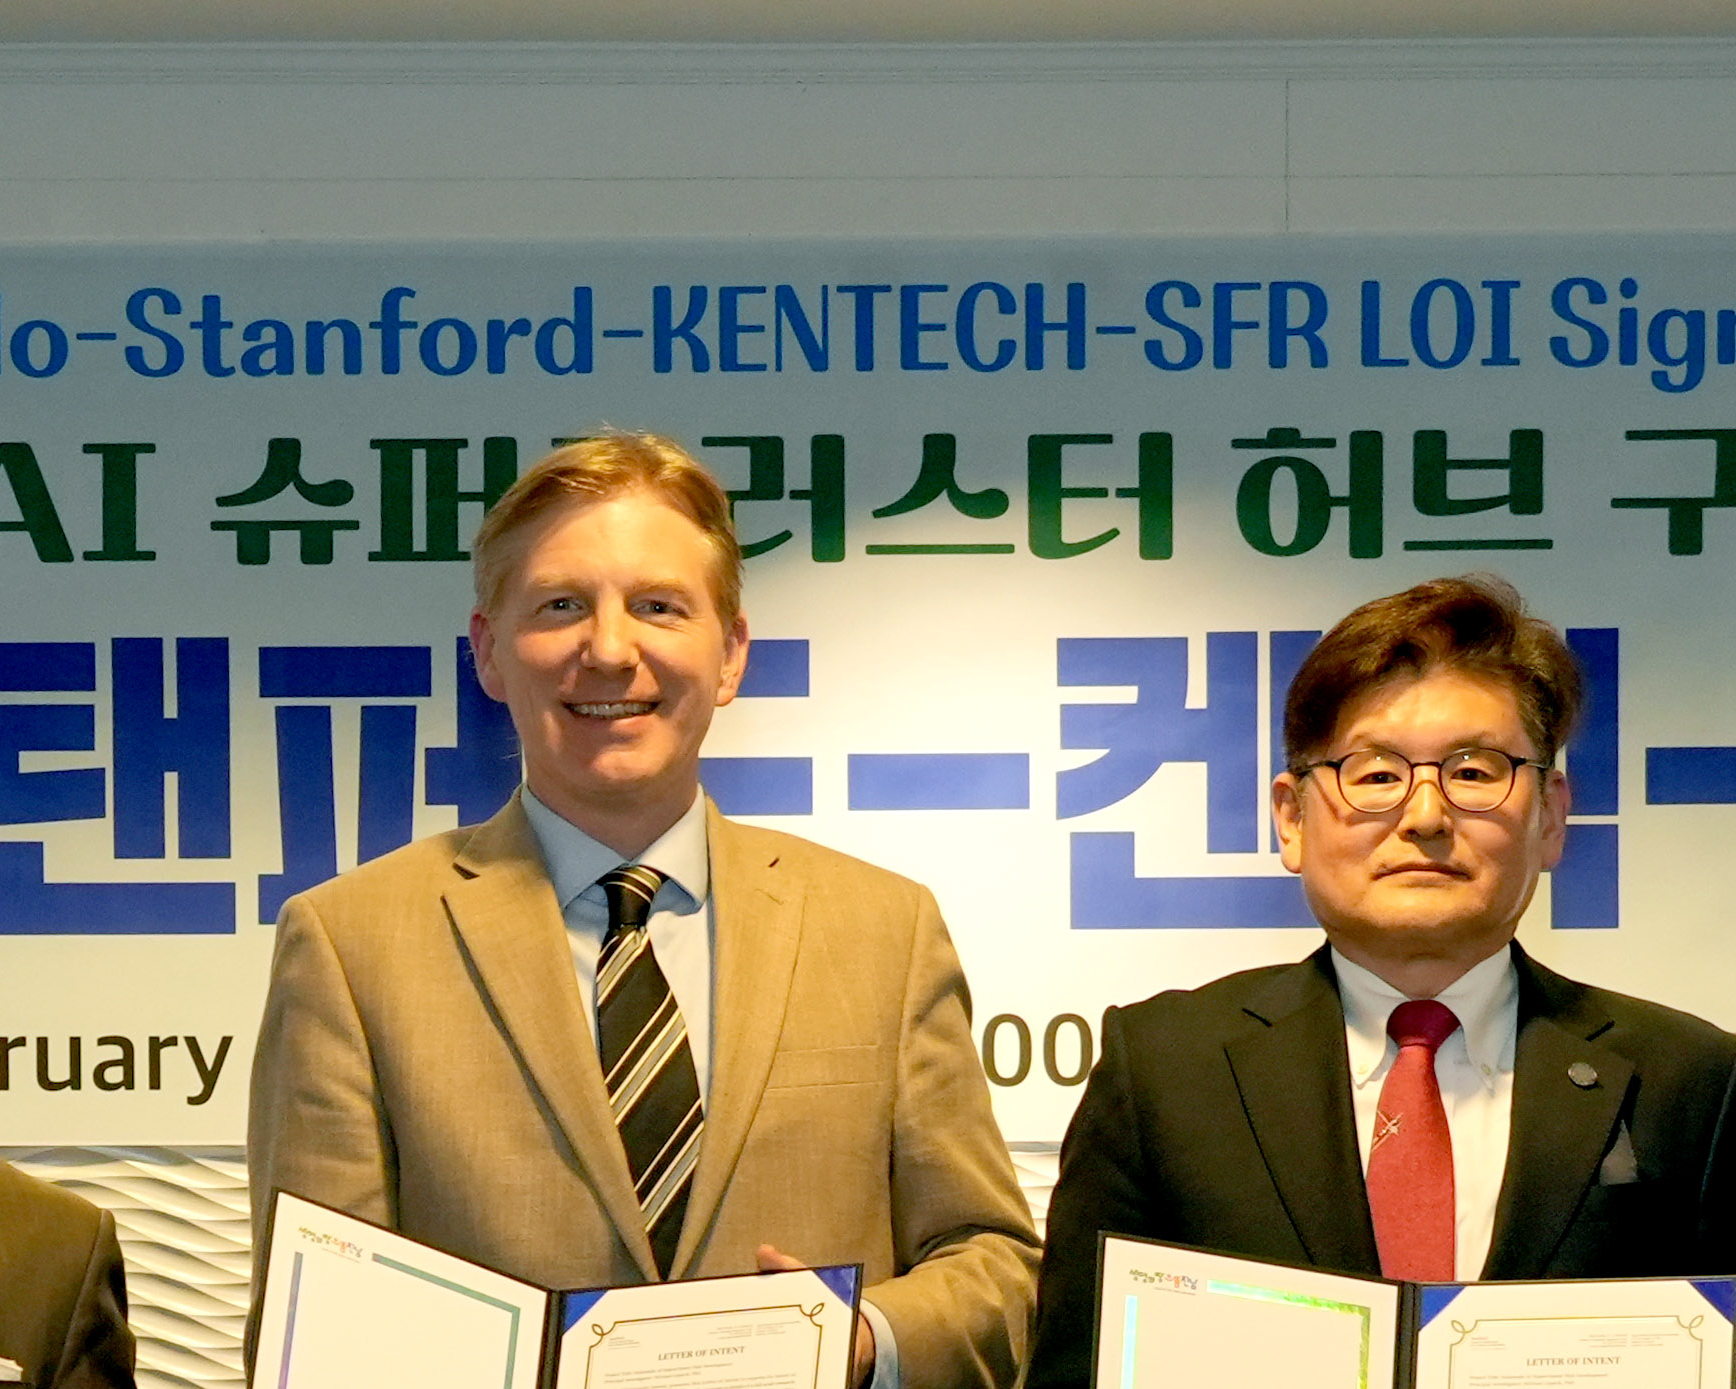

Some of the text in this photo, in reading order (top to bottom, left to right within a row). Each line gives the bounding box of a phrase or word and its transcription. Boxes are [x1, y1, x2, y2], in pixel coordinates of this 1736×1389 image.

[1361, 278, 1521, 369] LOI
[210, 432, 1173, 566] 슈퍼러스터
[1231, 428, 1553, 559] 허브
[657, 1346, 746, 1361] LETTER OF INTENT
[1526, 1356, 1622, 1367] LETTER OF INTENT
